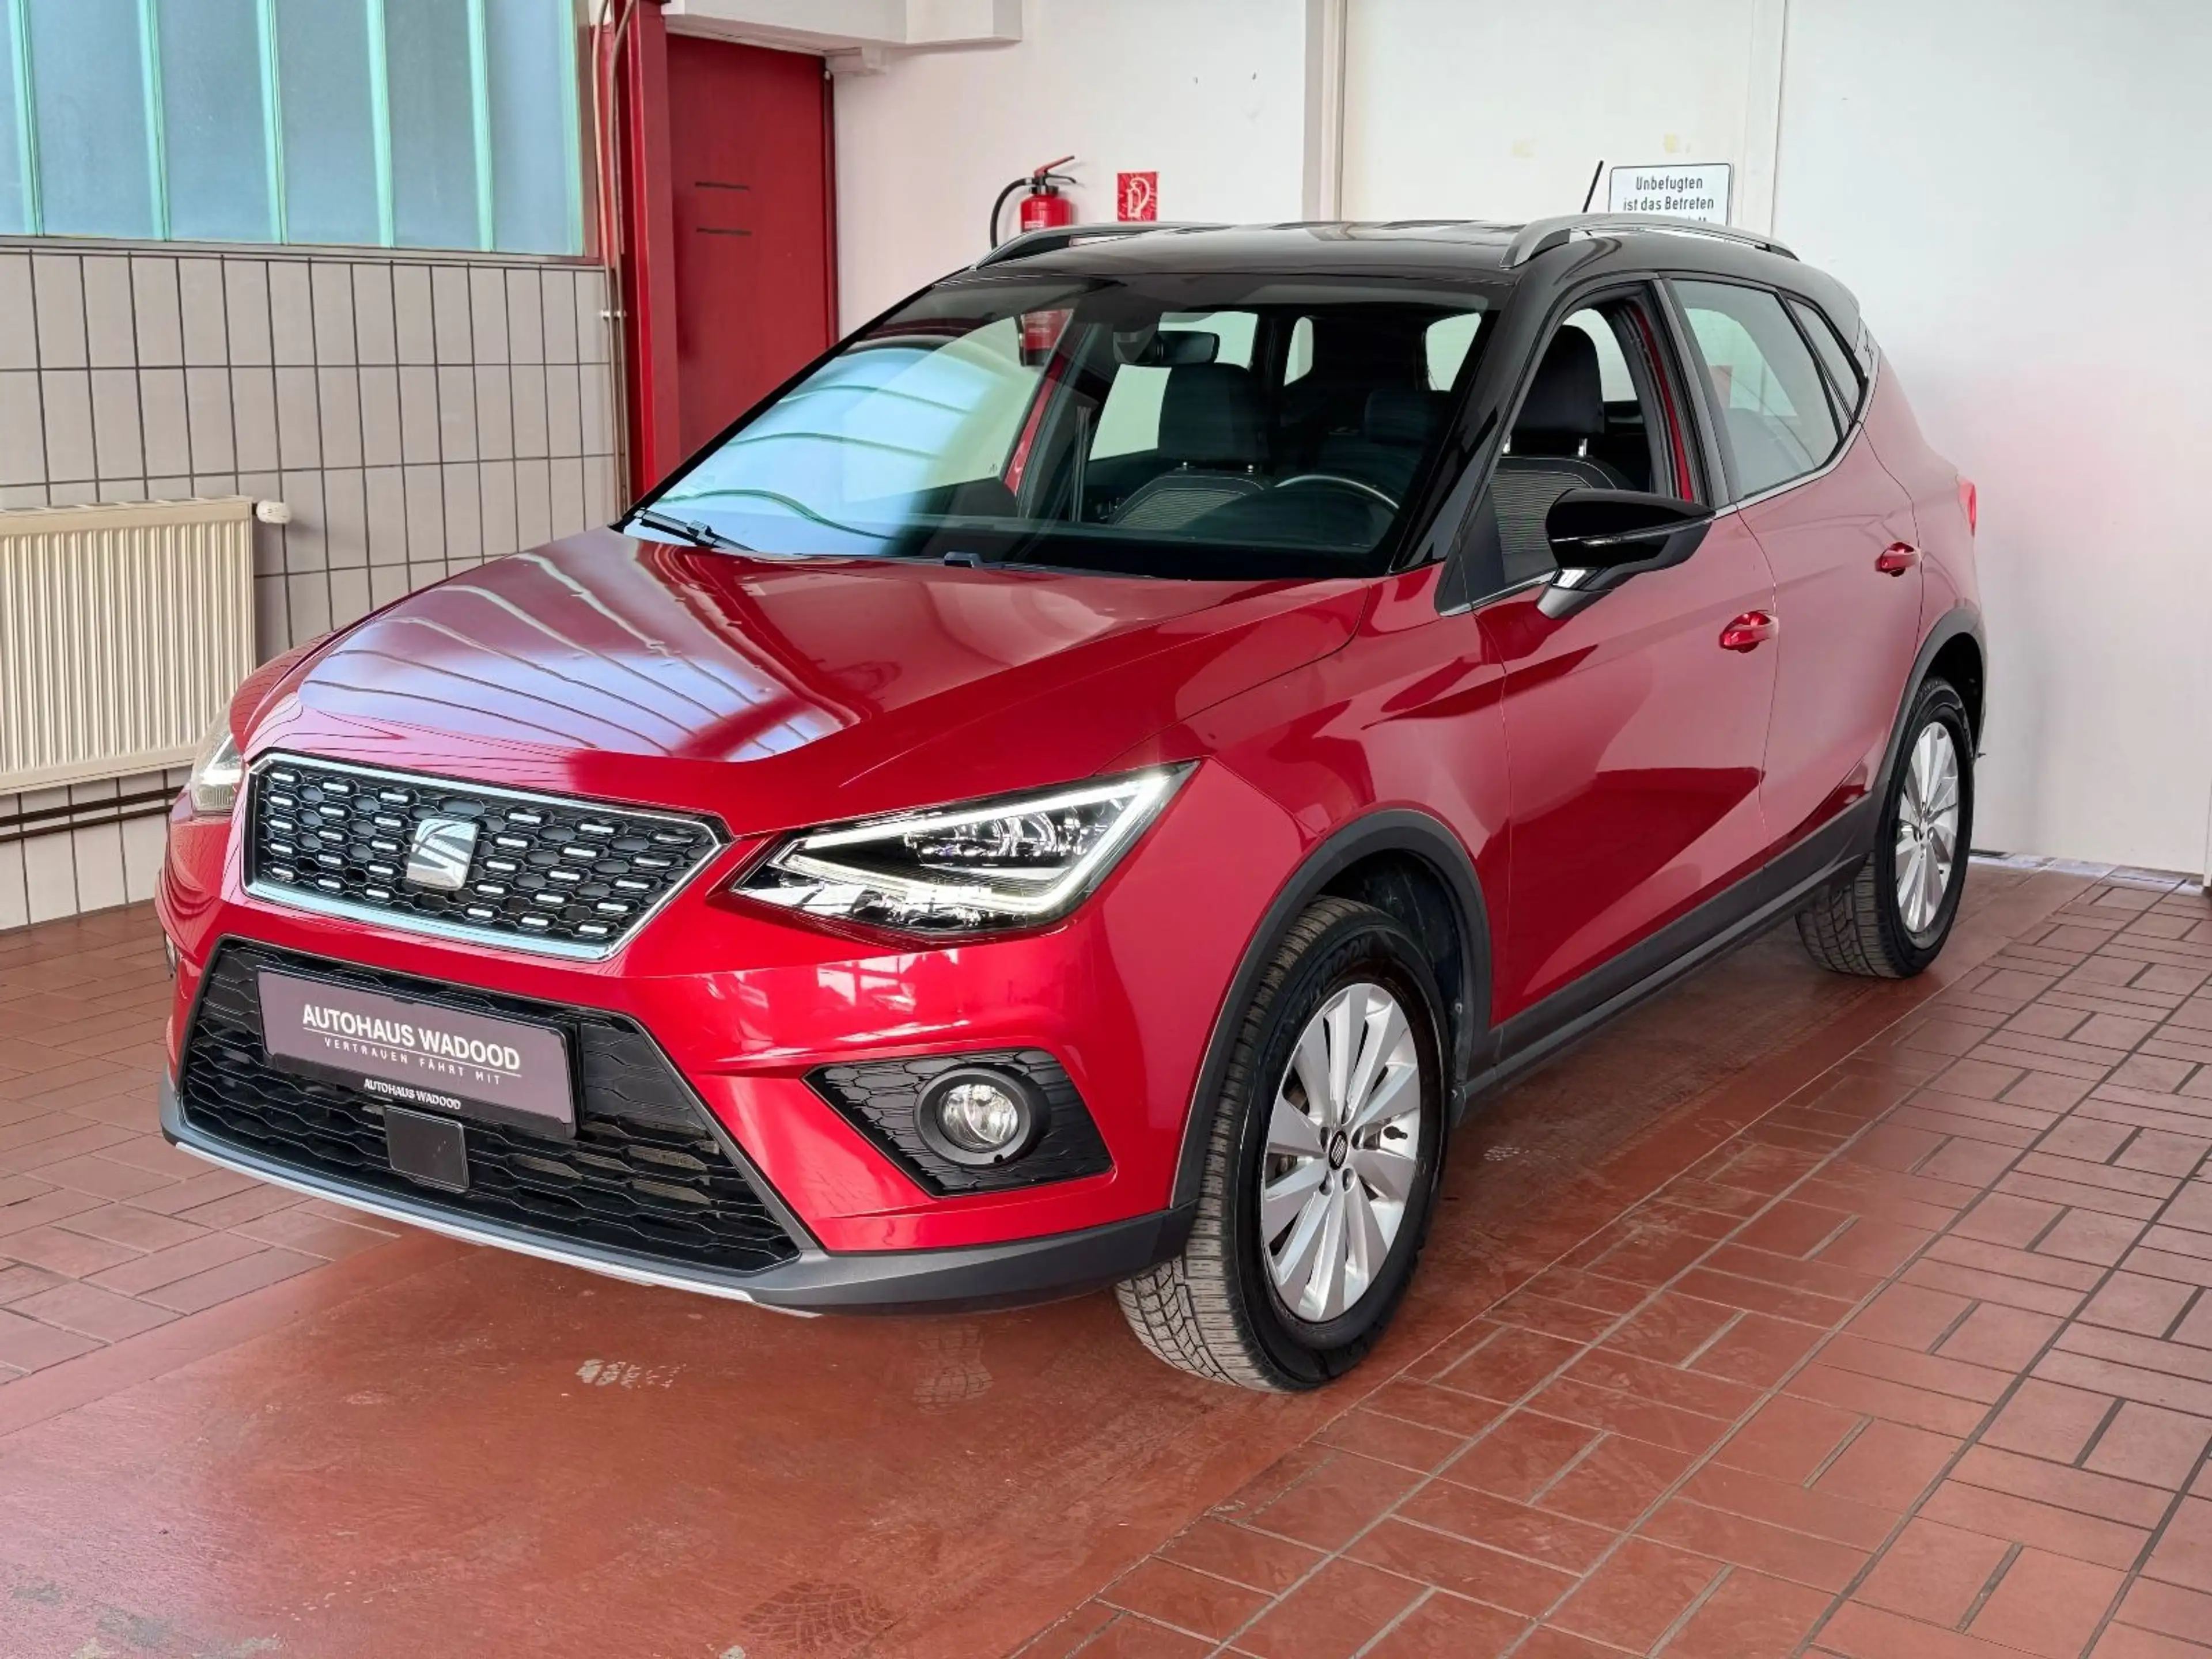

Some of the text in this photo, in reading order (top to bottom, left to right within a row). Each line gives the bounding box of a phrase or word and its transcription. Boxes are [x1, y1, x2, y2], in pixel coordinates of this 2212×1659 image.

[1635, 175, 1703, 192] Unbefugten
[1623, 196, 1714, 211] ist das Betreten
[302, 1003, 520, 1070] AUTOHAUS WADOOD
[325, 1037, 408, 1064] VERTRAUEN
[475, 1071, 501, 1085] MIT
[364, 1078, 461, 1110] AUTOHAUS WADOOD
